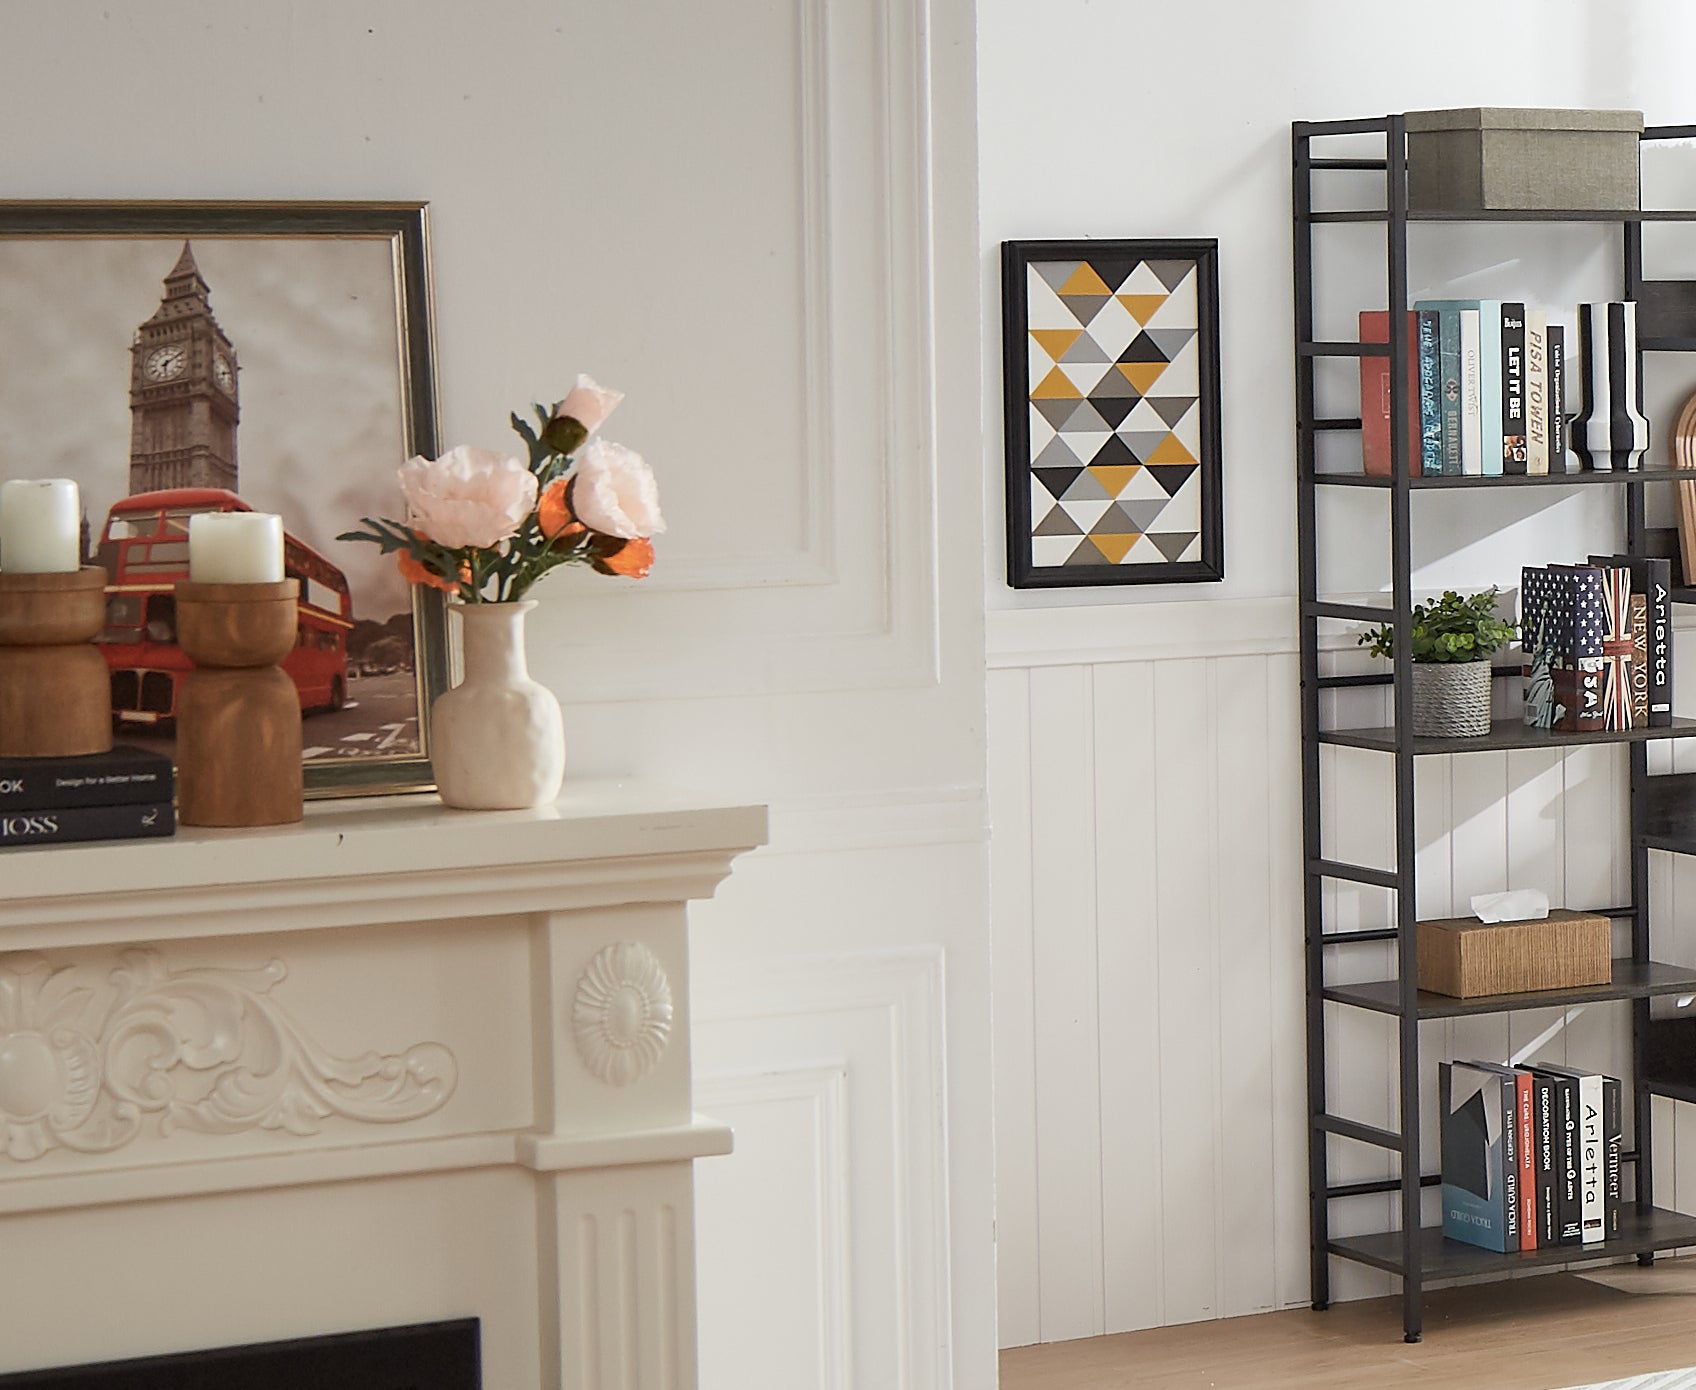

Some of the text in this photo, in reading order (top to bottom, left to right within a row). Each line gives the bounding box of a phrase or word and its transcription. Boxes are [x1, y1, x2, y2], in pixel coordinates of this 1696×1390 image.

[1468, 350, 1478, 417] OLIVER TWIST
[1509, 347, 1521, 419] LET IT BE
[1530, 331, 1544, 444] PISA TOWEN
[1634, 605, 1648, 718] NEW YORK
[1656, 584, 1667, 686] Arletta
[1584, 658, 1599, 708] USA
[86, 777, 97, 785] for
[4, 816, 60, 836] OSS
[1542, 1088, 1551, 1171] DECORATION BOOK
[1586, 1105, 1598, 1205] Arletta
[1609, 1134, 1622, 1199] Vermeer
[1507, 1174, 1516, 1236] TRICIA GUILD
